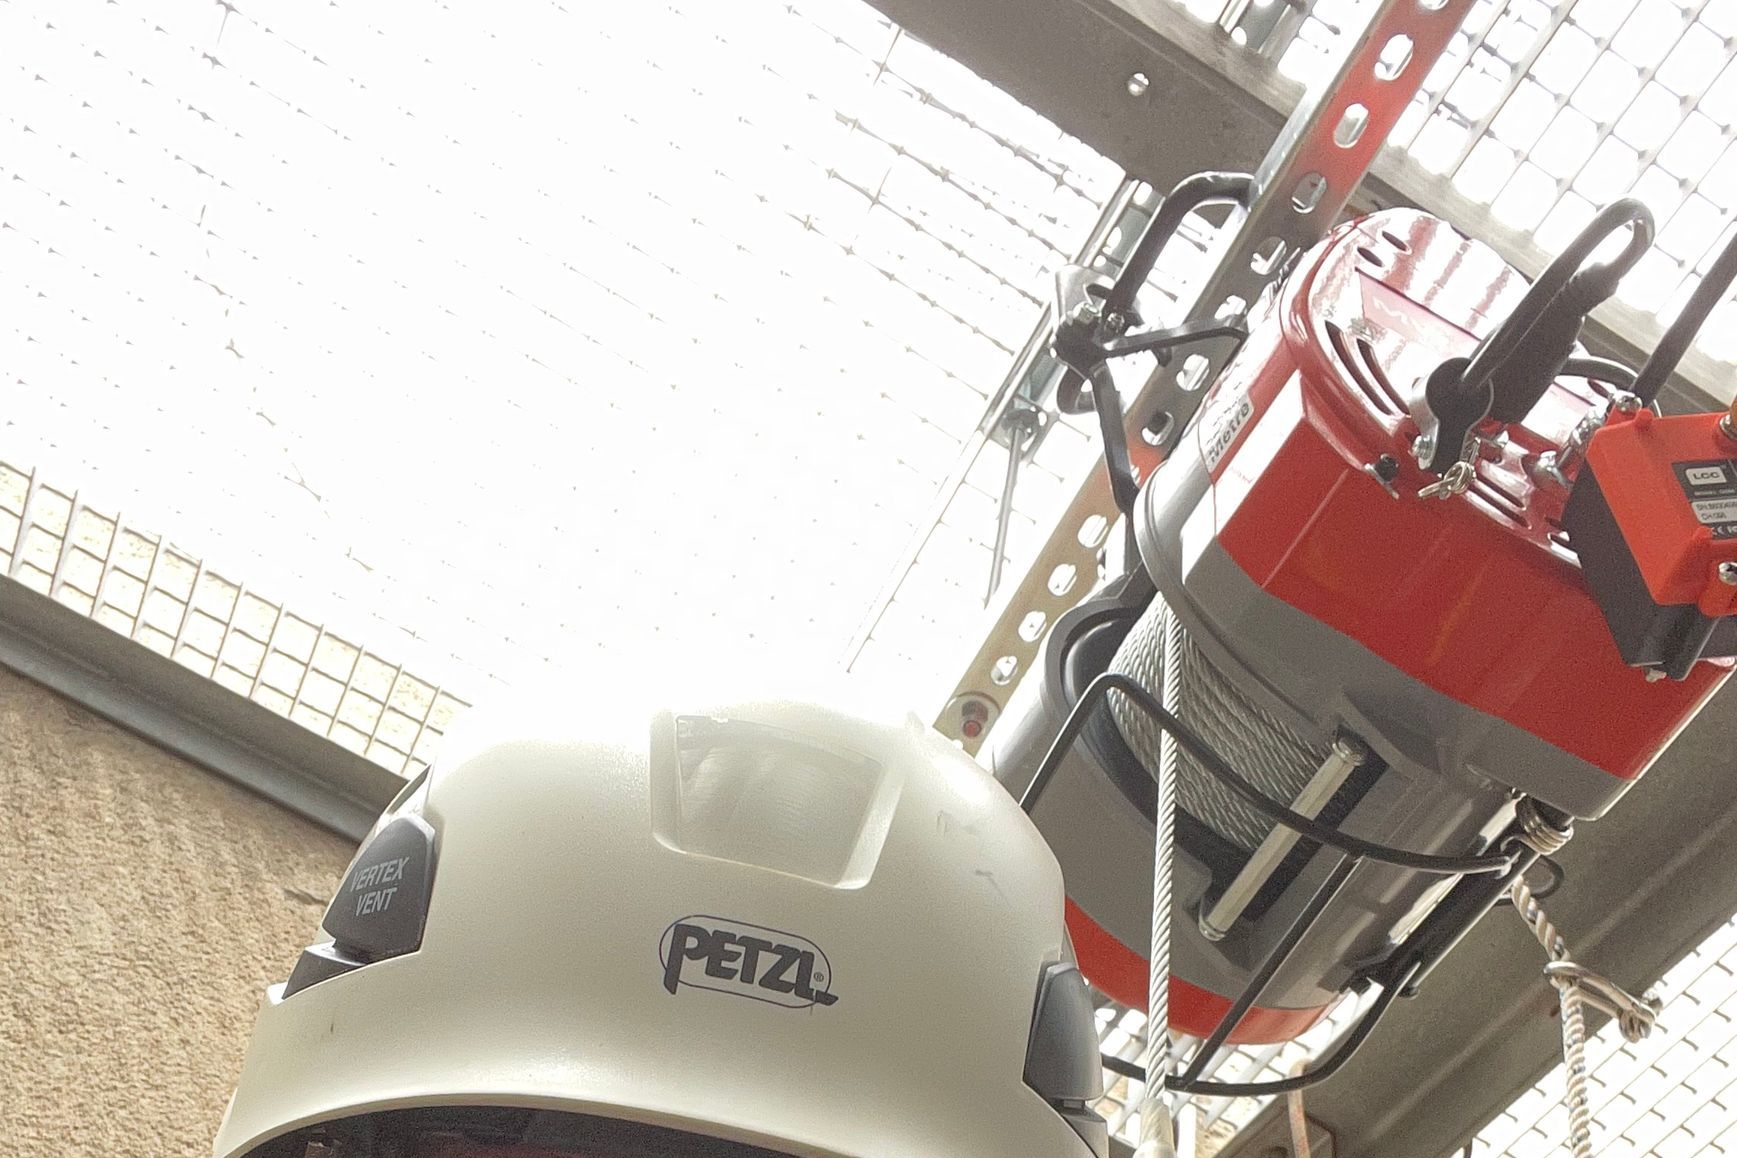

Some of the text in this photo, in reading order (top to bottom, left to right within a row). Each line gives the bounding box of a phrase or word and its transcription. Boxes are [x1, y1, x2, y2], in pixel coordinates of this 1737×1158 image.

[350, 856, 410, 892] VERTEX
[355, 887, 398, 917] VENT
[663, 923, 839, 1006] PETZL
